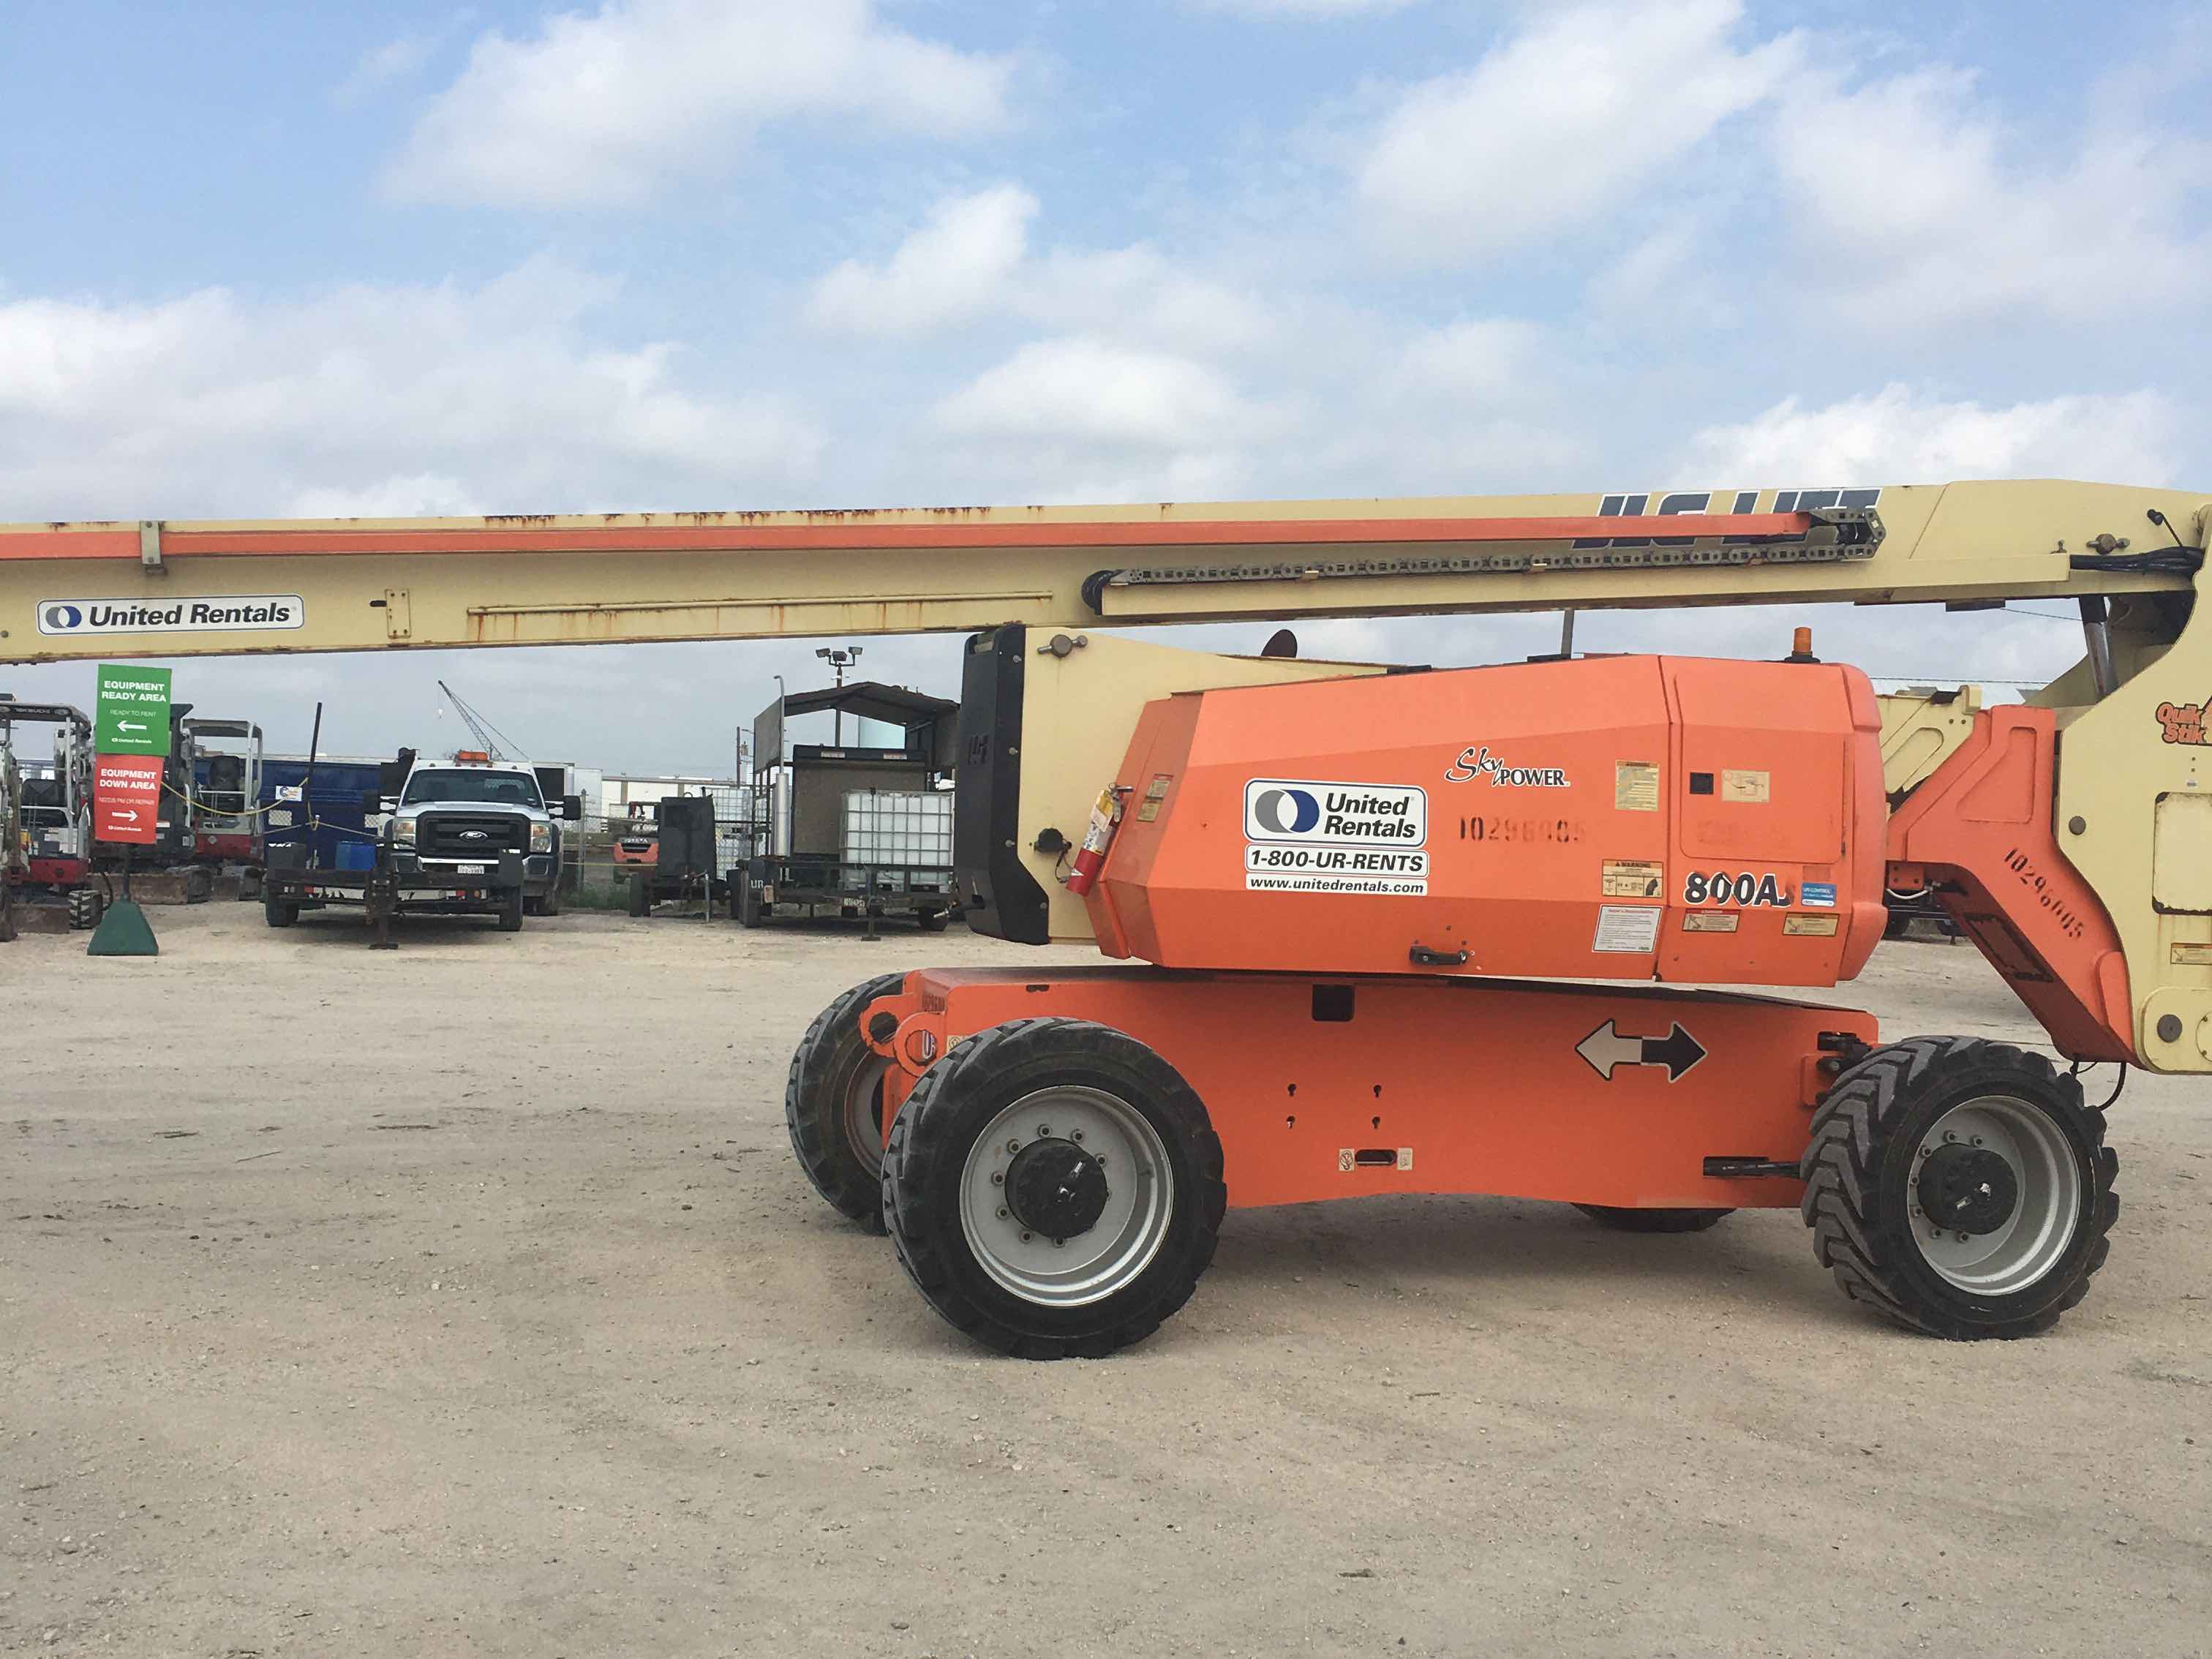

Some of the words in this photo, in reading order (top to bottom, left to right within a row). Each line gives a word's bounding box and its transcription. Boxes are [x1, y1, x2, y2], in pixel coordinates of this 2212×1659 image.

[89, 605, 183, 627] United
[189, 603, 290, 624] Rentals
[104, 680, 165, 691] EQUIPMENT
[101, 691, 136, 701] READY
[139, 693, 167, 702] AREA
[100, 768, 157, 780] EQUIPMENT
[99, 779, 128, 789] DOWN
[129, 780, 156, 790] AREA
[1325, 792, 1410, 816] United
[1324, 815, 1416, 838] Rentals
[1251, 850, 1423, 872] 1-800-UR-RENTS
[750, 879, 764, 889] UR
[1250, 879, 1424, 893] www.unitedrentals.com
